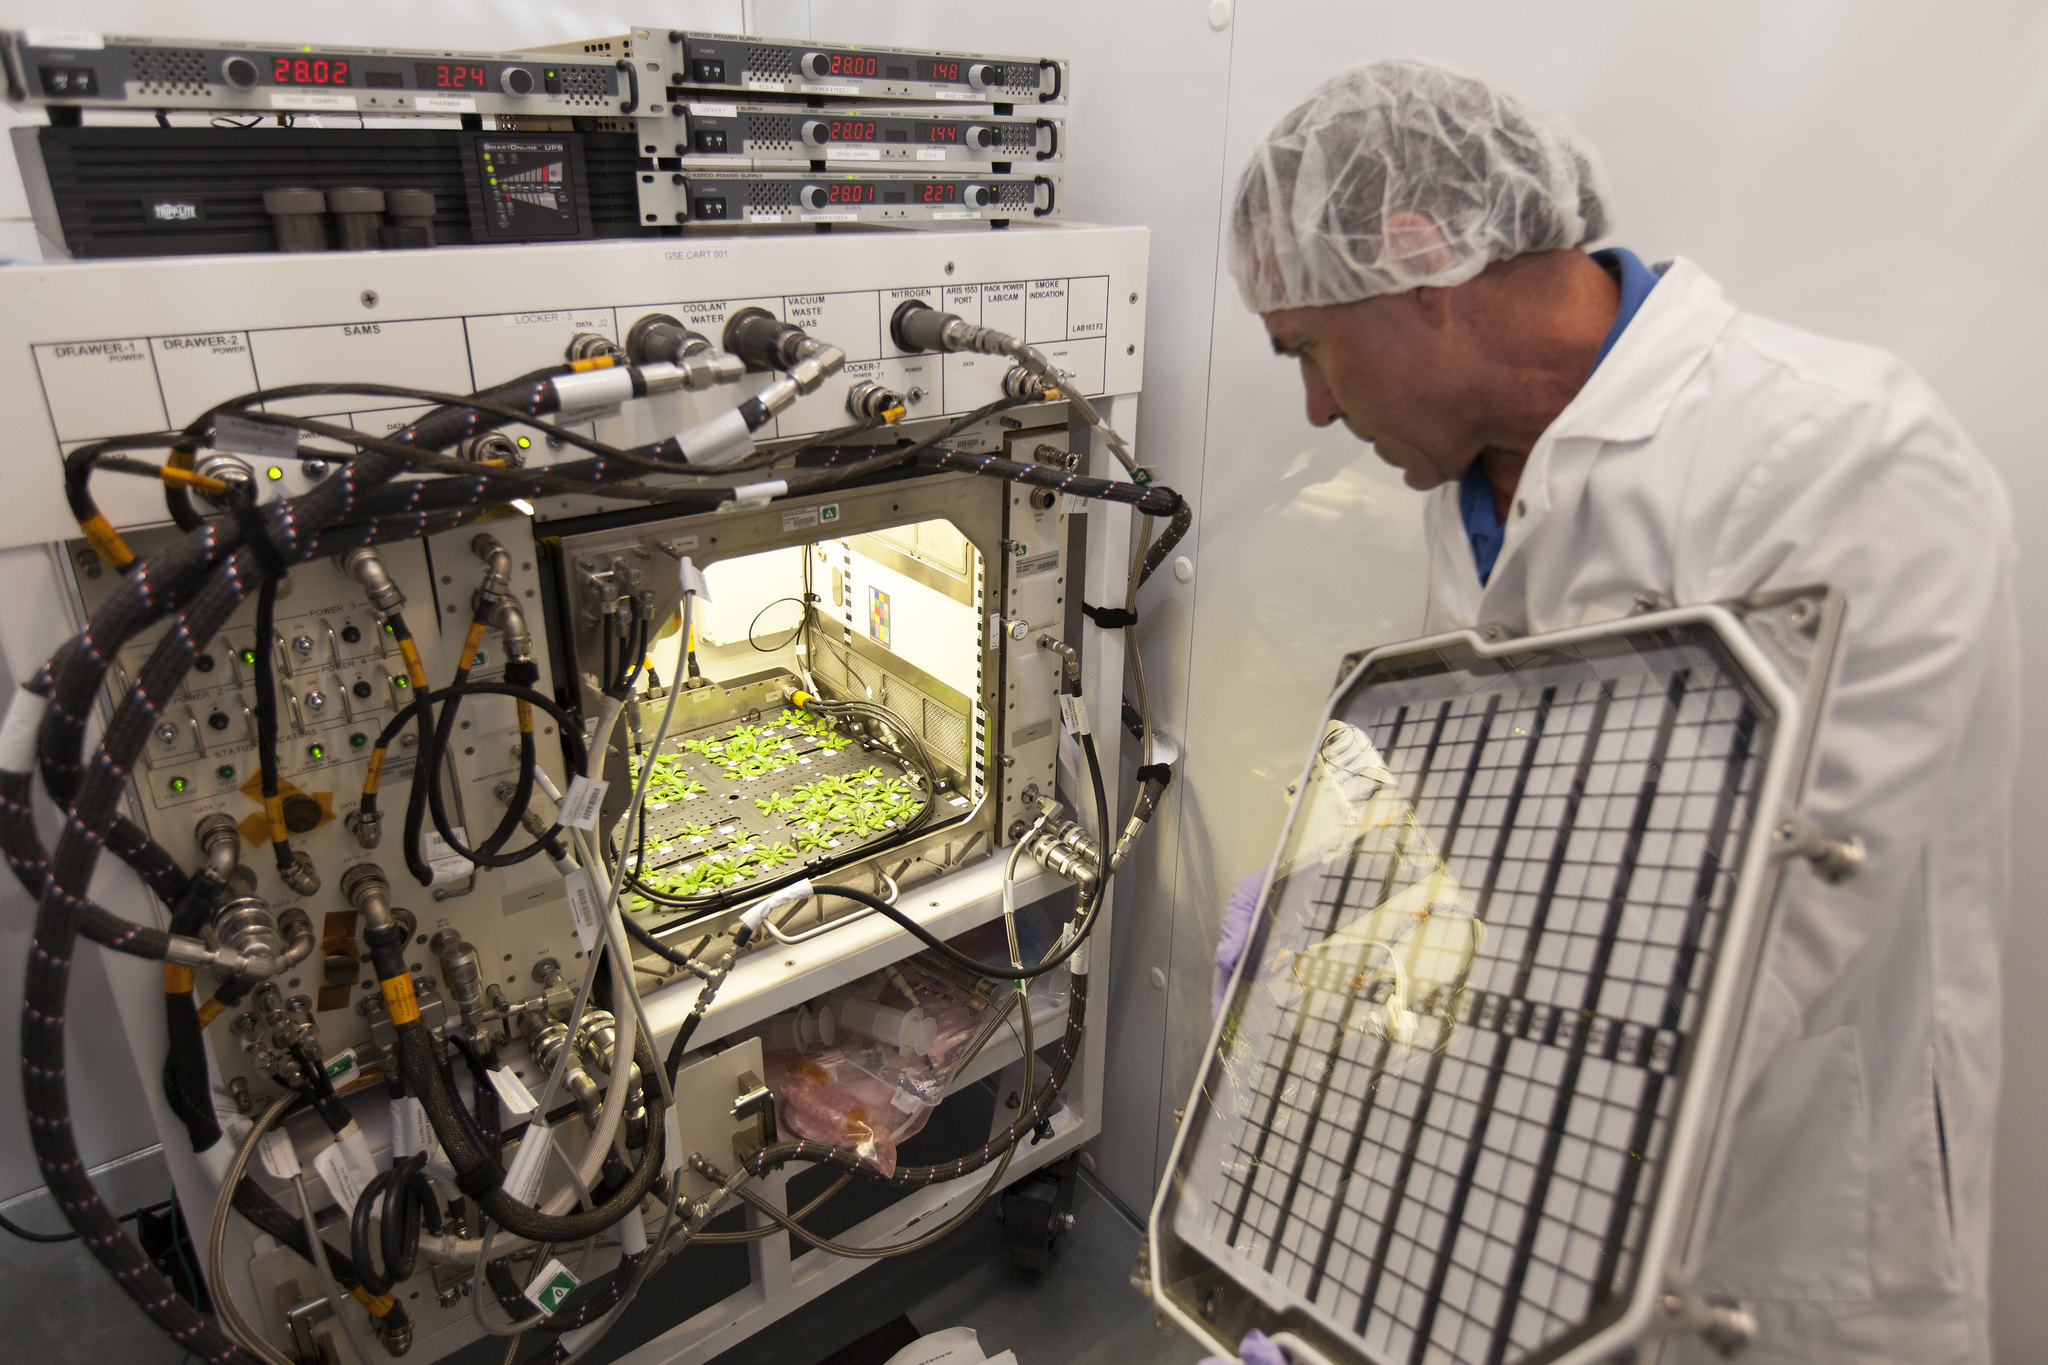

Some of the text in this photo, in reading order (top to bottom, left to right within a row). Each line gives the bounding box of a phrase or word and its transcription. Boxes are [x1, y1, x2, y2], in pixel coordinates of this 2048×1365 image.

[831, 56, 876, 75] 28.00
[274, 59, 347, 84] 28.02
[438, 66, 483, 87] 3.24
[932, 63, 958, 80] 1.48
[831, 122, 875, 140] 28.02
[931, 127, 956, 141] 1.44
[830, 185, 873, 202] 28.01
[924, 185, 954, 202] 2.27
[664, 250, 729, 261] GSE CART 001
[946, 286, 978, 295] ARIS 1553
[1002, 283, 1024, 291] POWER
[1035, 281, 1059, 289] SMOKE
[891, 289, 932, 299] NITROGEN
[988, 293, 1019, 303] LAB/CAM
[1029, 290, 1065, 300] INDICATION
[788, 296, 825, 305] VACUUM
[954, 297, 973, 305] PORT
[683, 302, 728, 313] COOLANT
[792, 307, 823, 317] WASTE
[515, 313, 558, 325] LOCKER
[566, 312, 574, 321] 3
[575, 318, 609, 328] DATA J2
[690, 314, 725, 324] WATER
[799, 319, 818, 328] GAS
[343, 325, 381, 336] SAMS
[1096, 323, 1104, 331] F2
[163, 336, 238, 351] DRAWER-2
[55, 343, 136, 358] DRAWER-1
[212, 346, 246, 355] POWER
[109, 353, 145, 362] POWER
[843, 362, 881, 373] LOCKER-7
[875, 371, 885, 380] J1
[309, 605, 344, 617] POWER
[321, 660, 355, 673] POWER
[173, 690, 212, 704] POWER
[215, 744, 255, 758] STATUS
[193, 803, 214, 814] DATA
[339, 801, 358, 810] DATA
[343, 854, 361, 864] DATA
